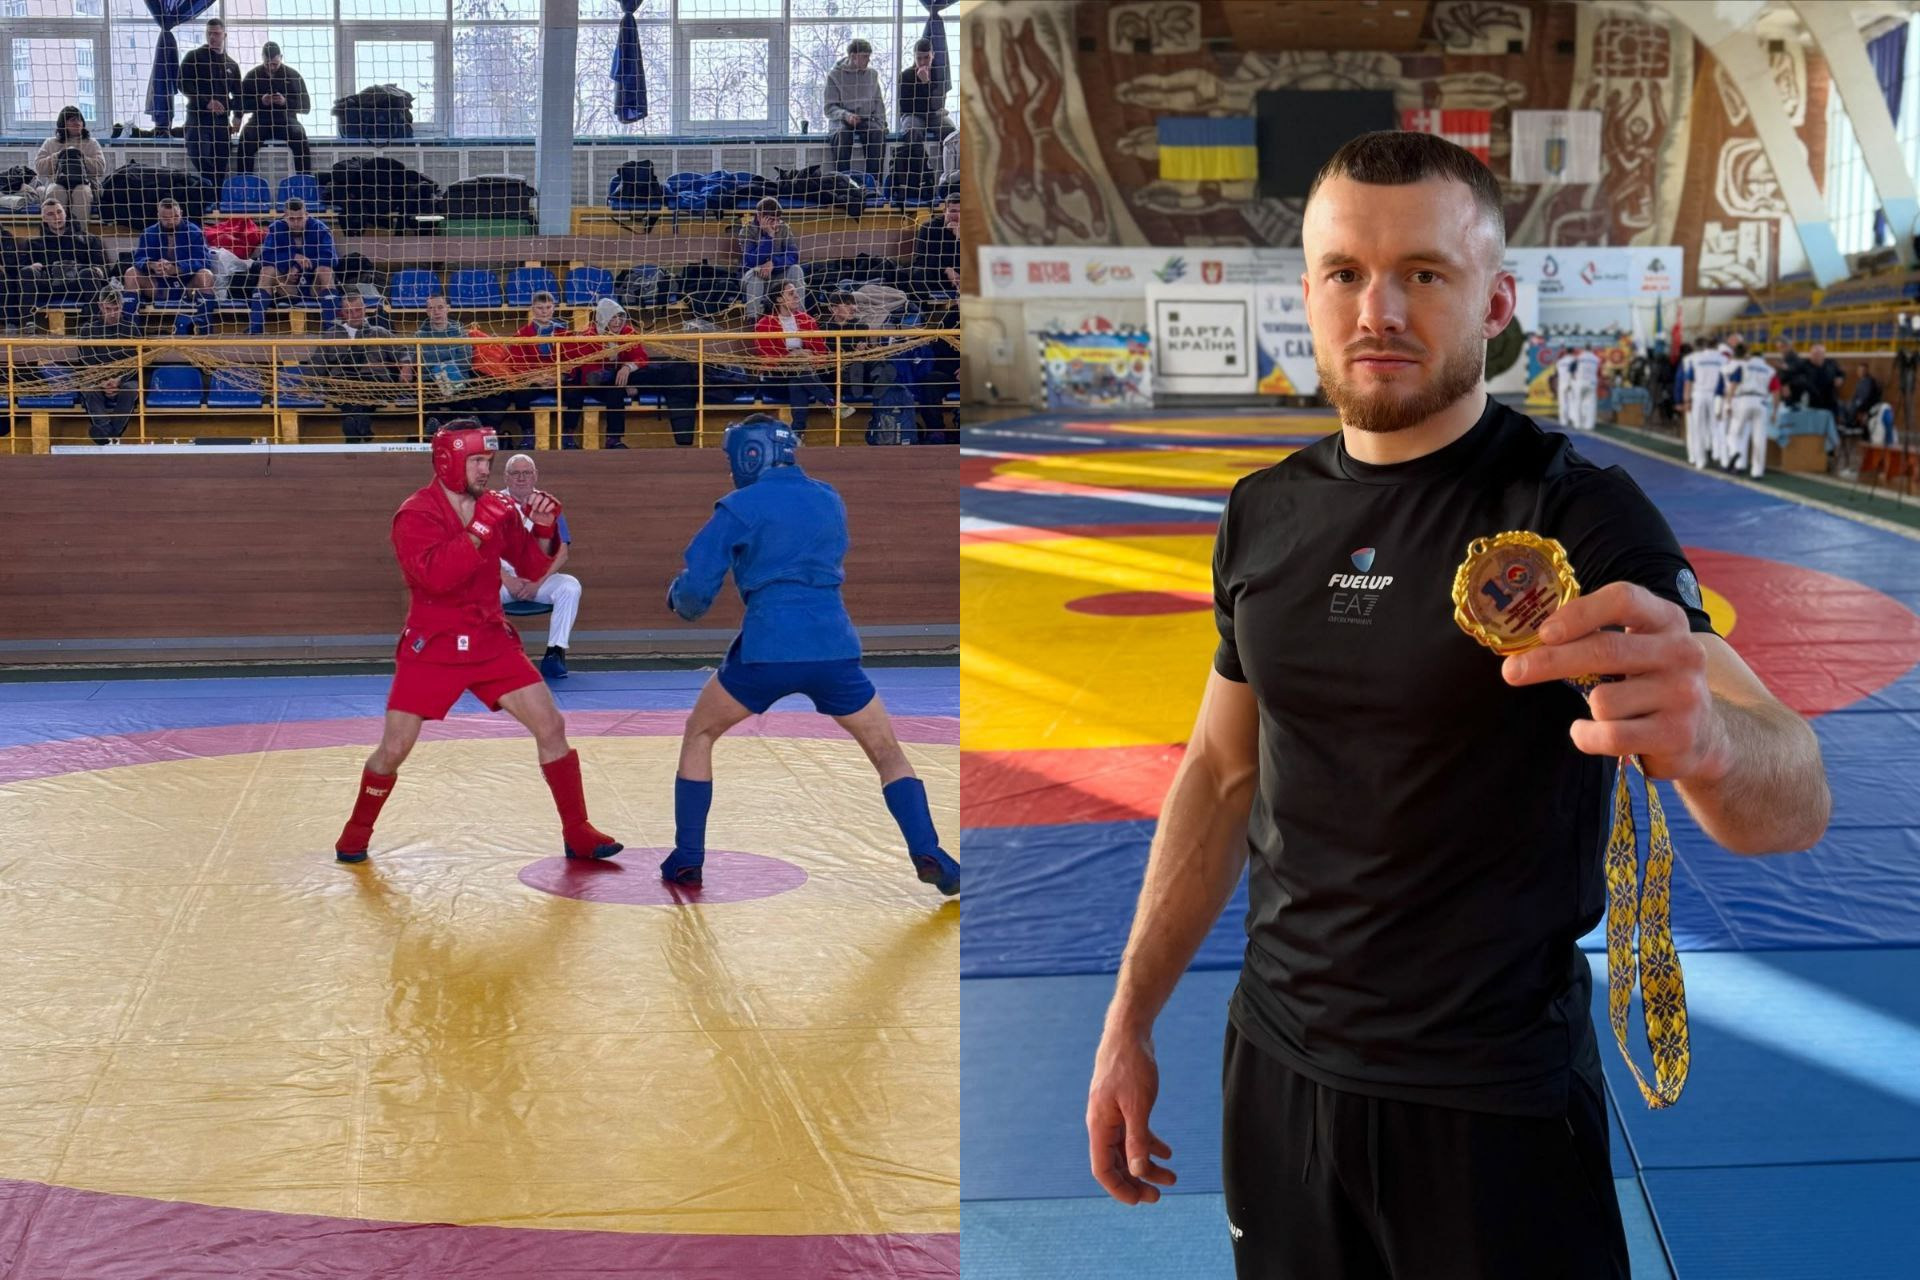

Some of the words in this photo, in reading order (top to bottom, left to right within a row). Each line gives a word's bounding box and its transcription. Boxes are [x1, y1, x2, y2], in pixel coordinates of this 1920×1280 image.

[1168, 325, 1235, 337] ВАРТА
[1168, 338, 1236, 351] КРАЇНИ
[1328, 573, 1394, 590] FUELUP
[1329, 592, 1380, 616] EA7
